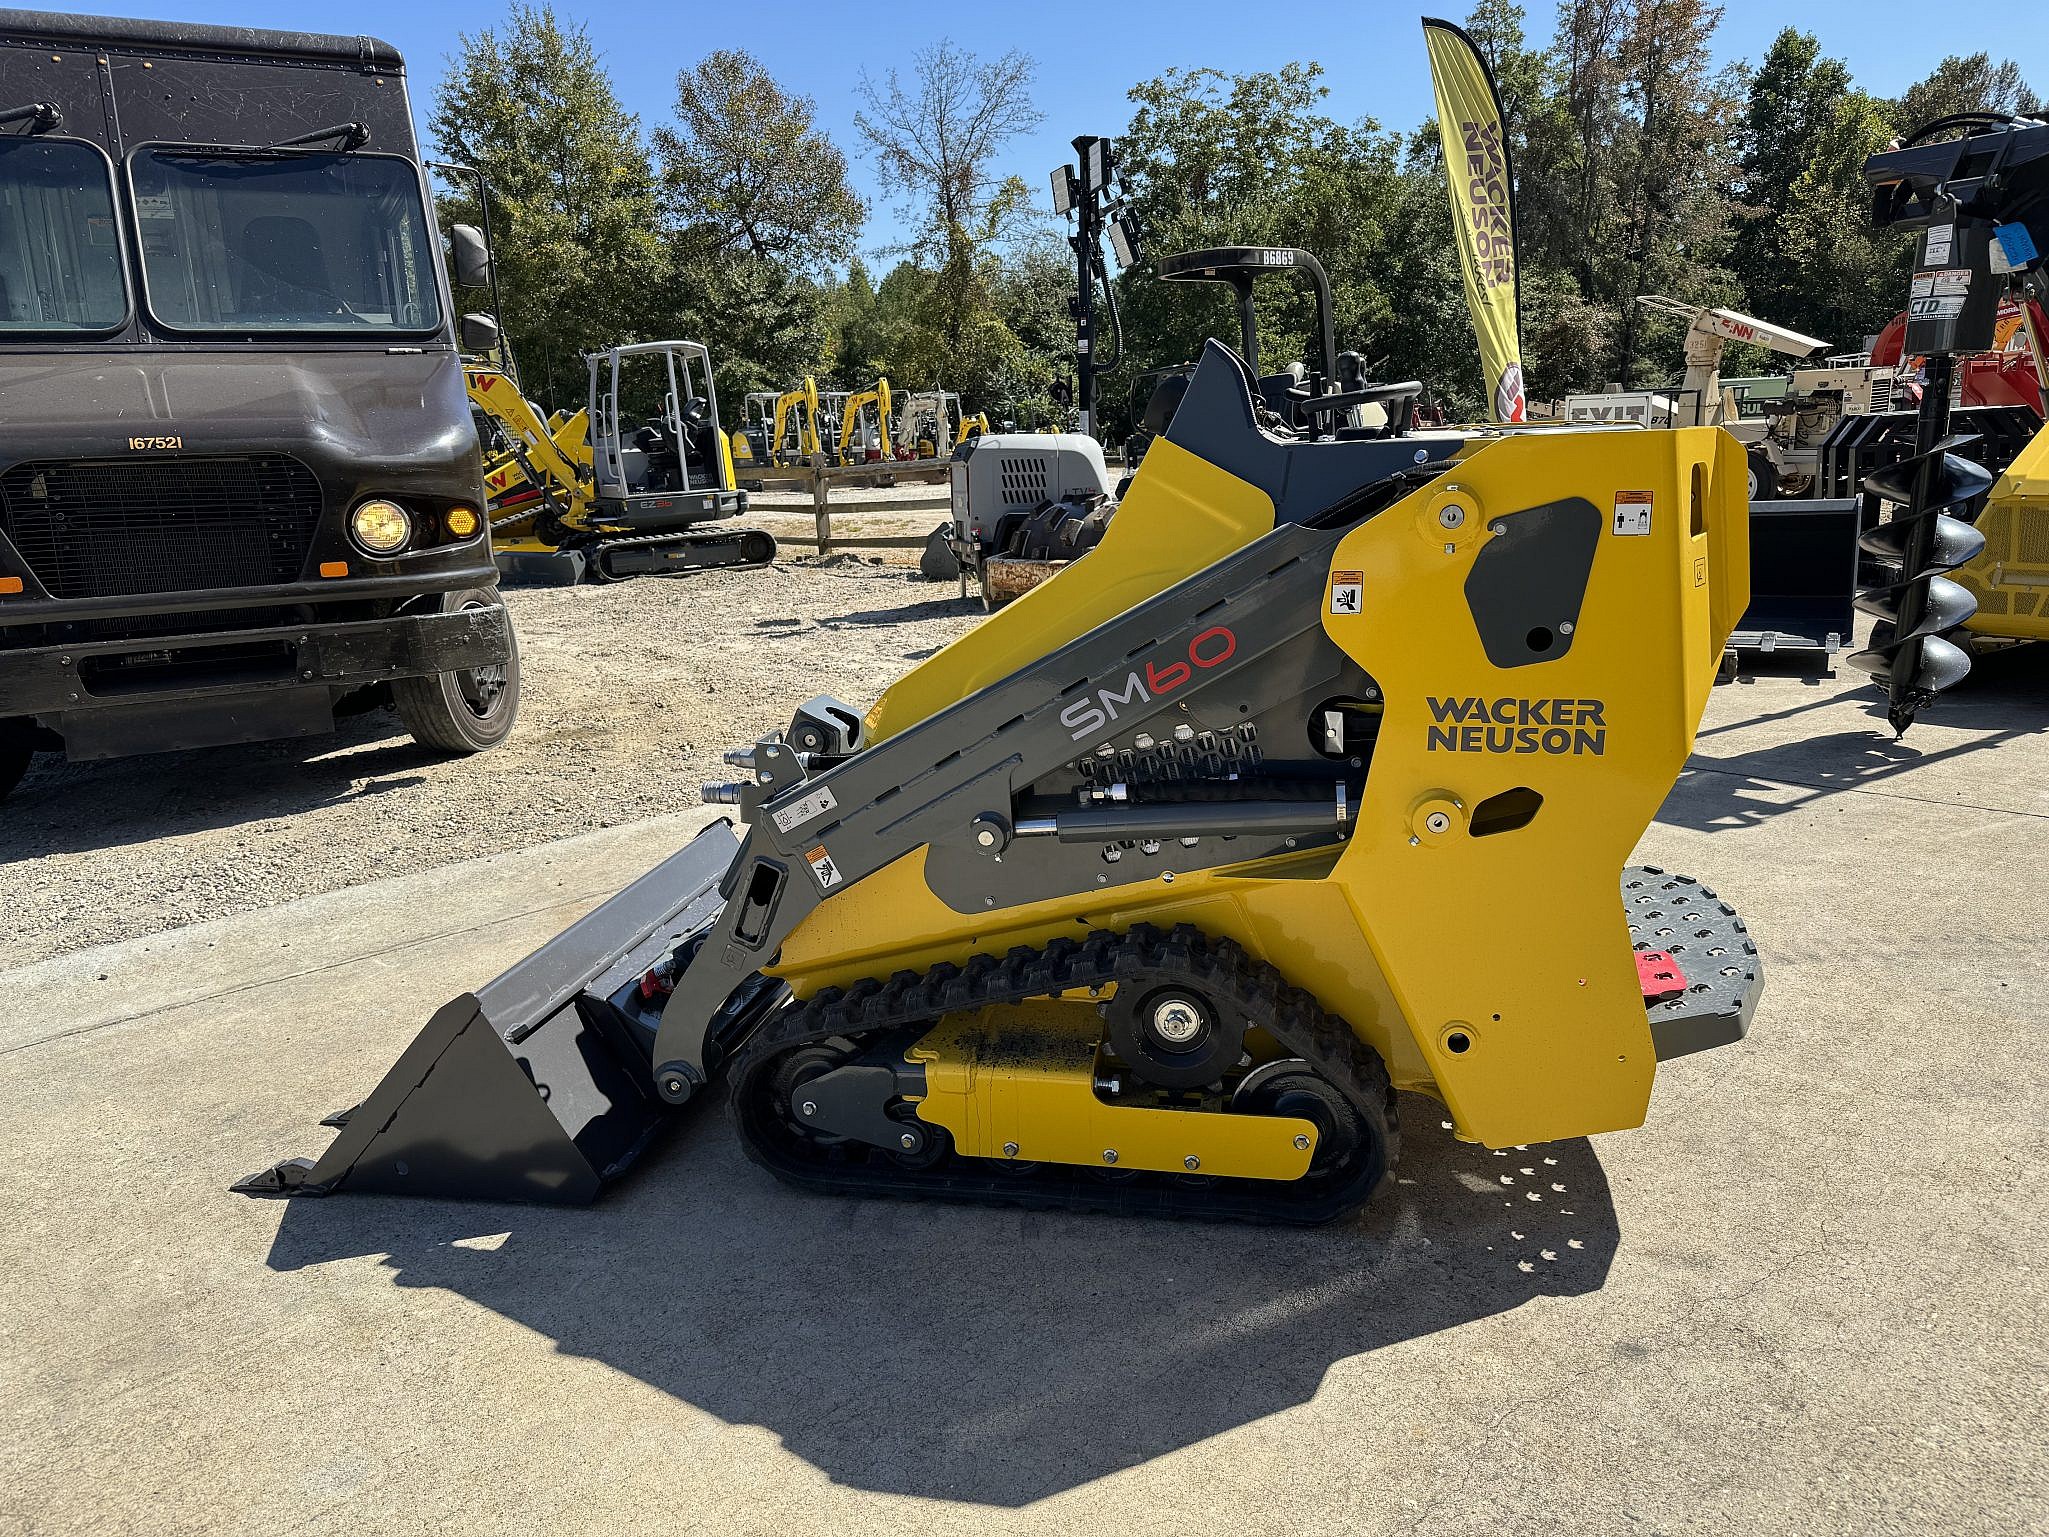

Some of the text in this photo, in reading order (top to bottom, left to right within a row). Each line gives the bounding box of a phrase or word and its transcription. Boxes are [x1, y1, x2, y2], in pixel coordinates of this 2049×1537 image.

[1463, 121, 1496, 288] NEUSON
[1480, 120, 1511, 288] WACKER
[1263, 250, 1294, 266] B6869
[128, 436, 183, 450] 167521
[1060, 626, 1237, 742] SM60
[1425, 696, 1607, 727] WACKER
[1427, 726, 1606, 756] NEUSON
